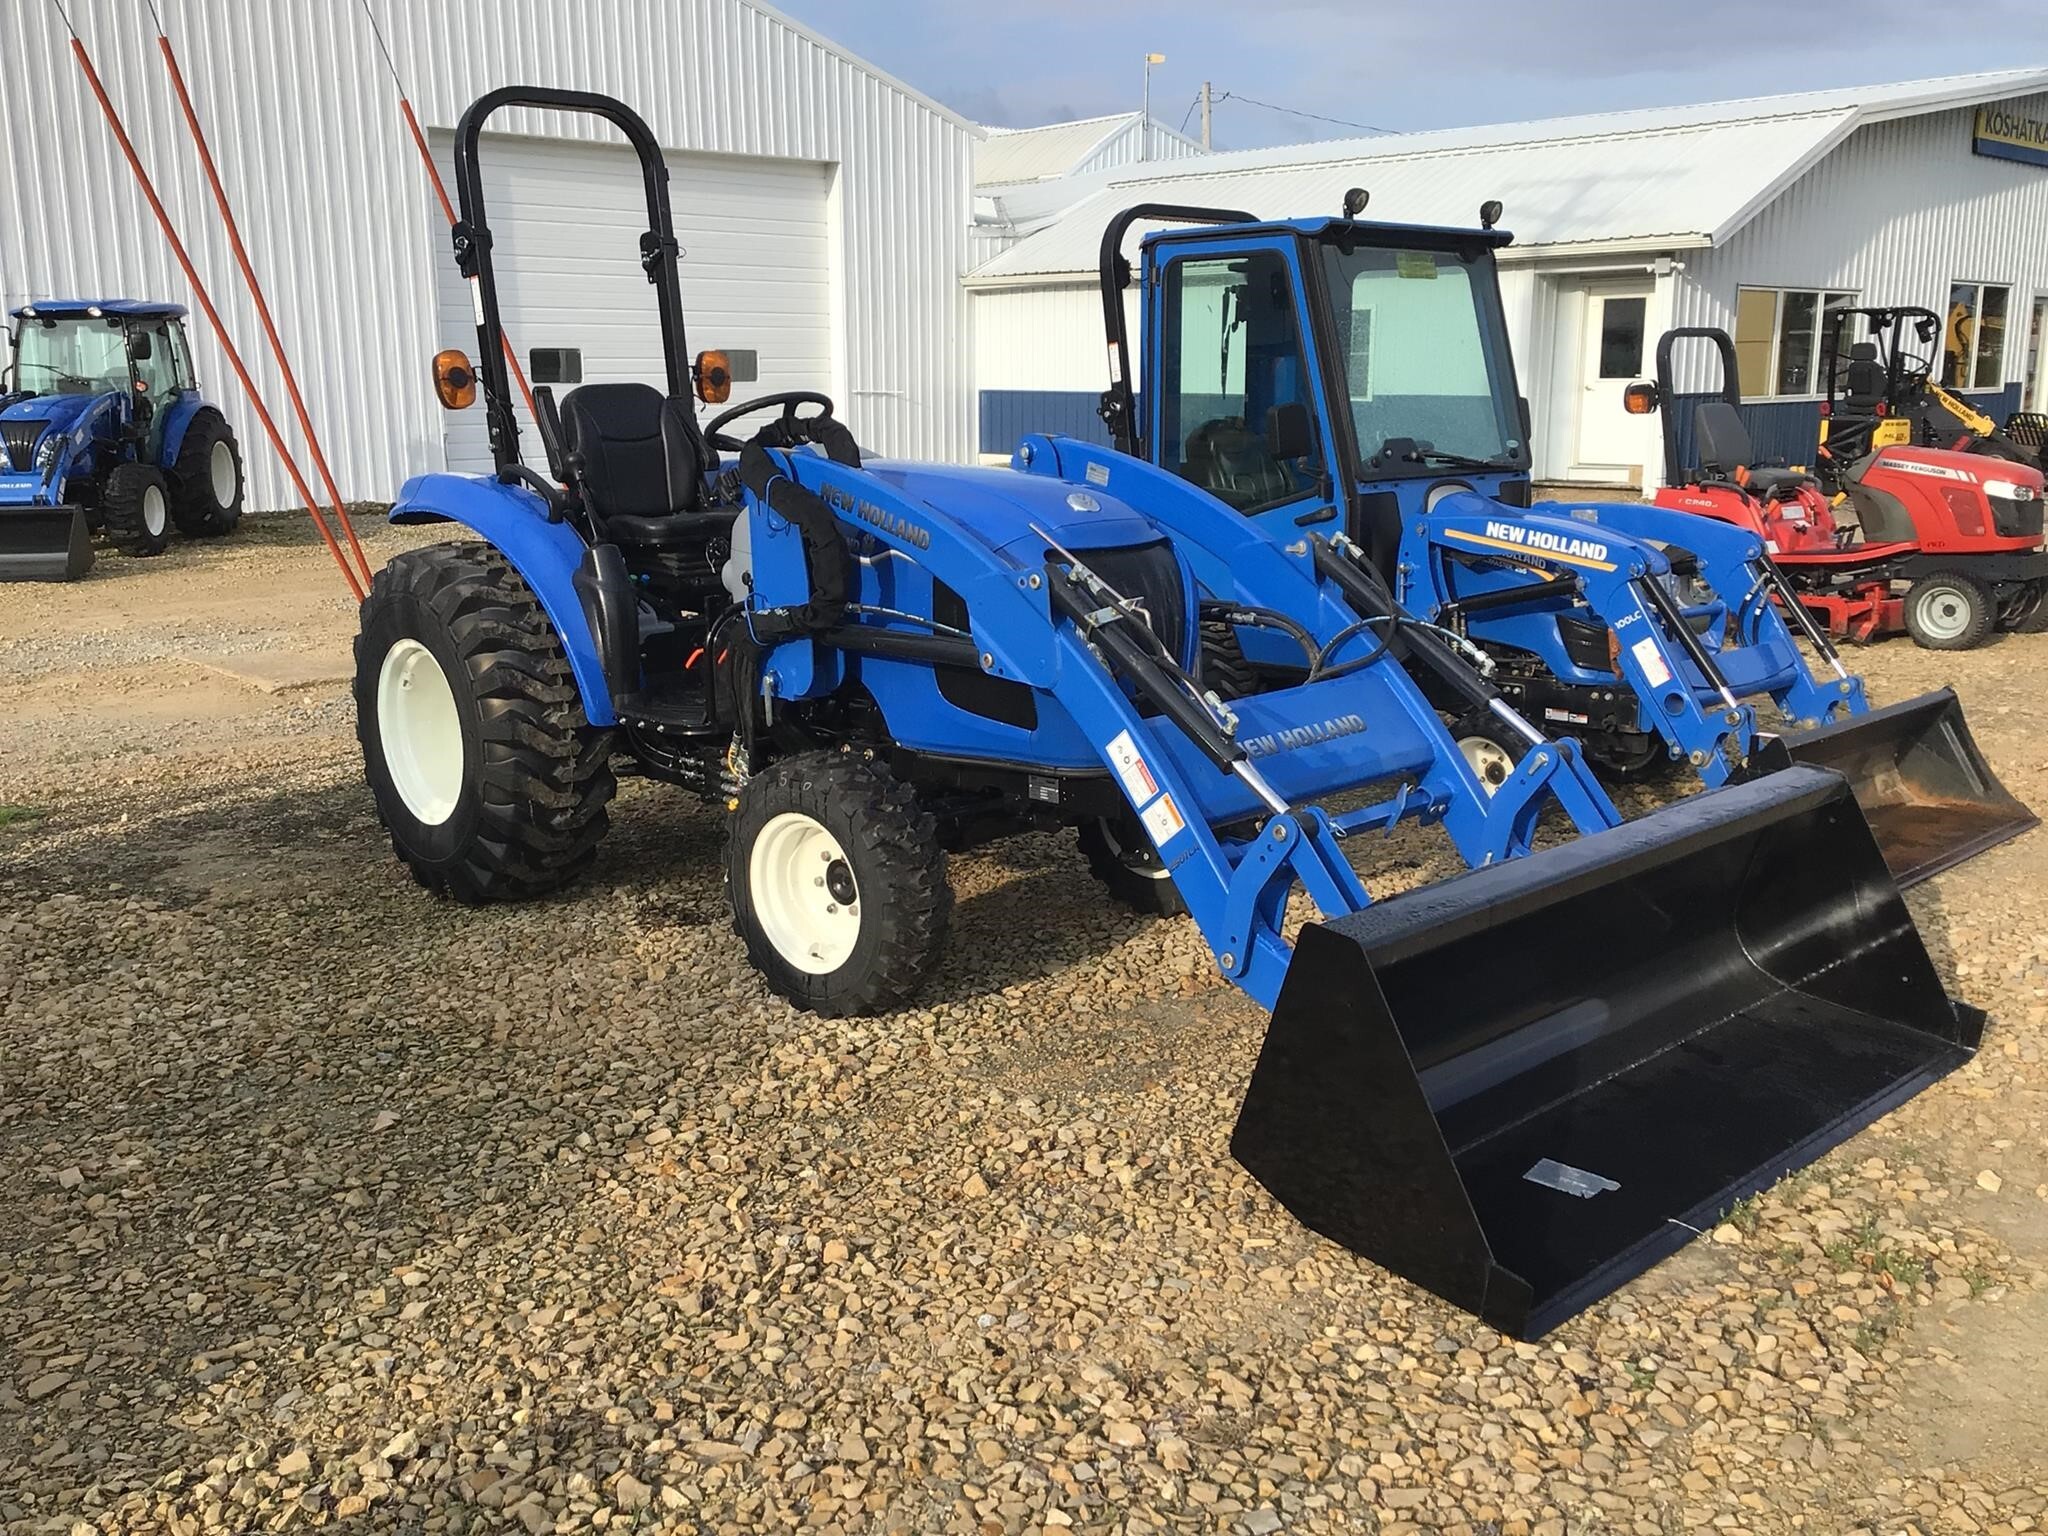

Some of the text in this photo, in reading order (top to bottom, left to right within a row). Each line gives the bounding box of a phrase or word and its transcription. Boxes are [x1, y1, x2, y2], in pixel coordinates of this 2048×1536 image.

[821, 481, 931, 551] NEW HOLLAND
[1486, 521, 1608, 562] NEW HOLLAND
[1614, 609, 1642, 630] 100LC
[1278, 714, 1367, 751] HOLLAND
